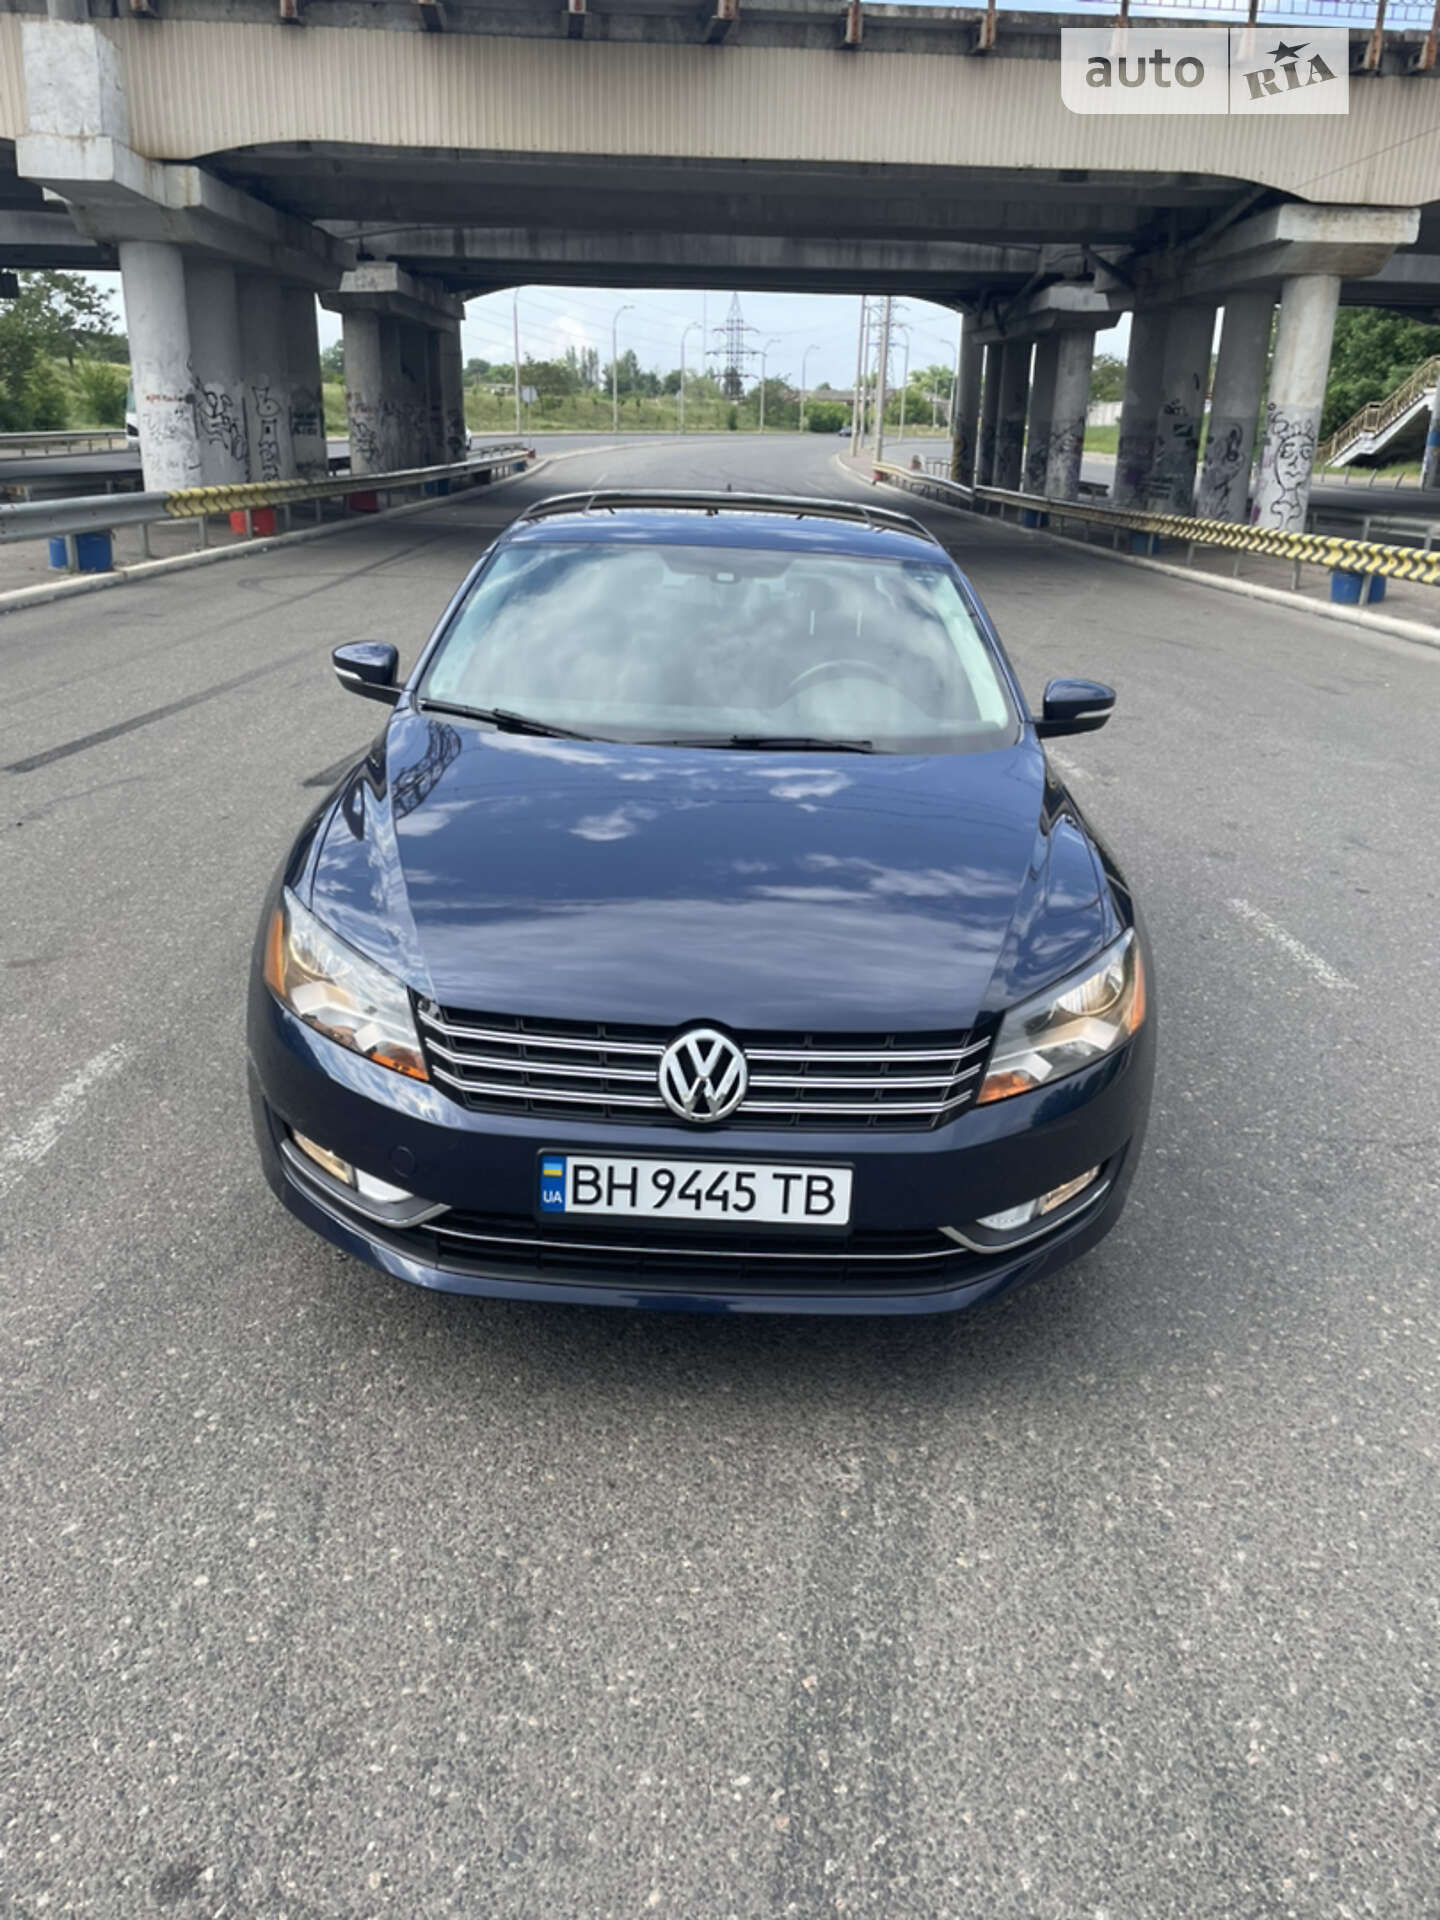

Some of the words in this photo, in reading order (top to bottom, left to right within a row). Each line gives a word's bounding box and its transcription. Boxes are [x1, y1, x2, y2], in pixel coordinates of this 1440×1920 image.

[542, 1190, 562, 1204] UA
[571, 1164, 638, 1208] BH
[651, 1168, 757, 1213] 9445
[771, 1172, 836, 1216] TB
